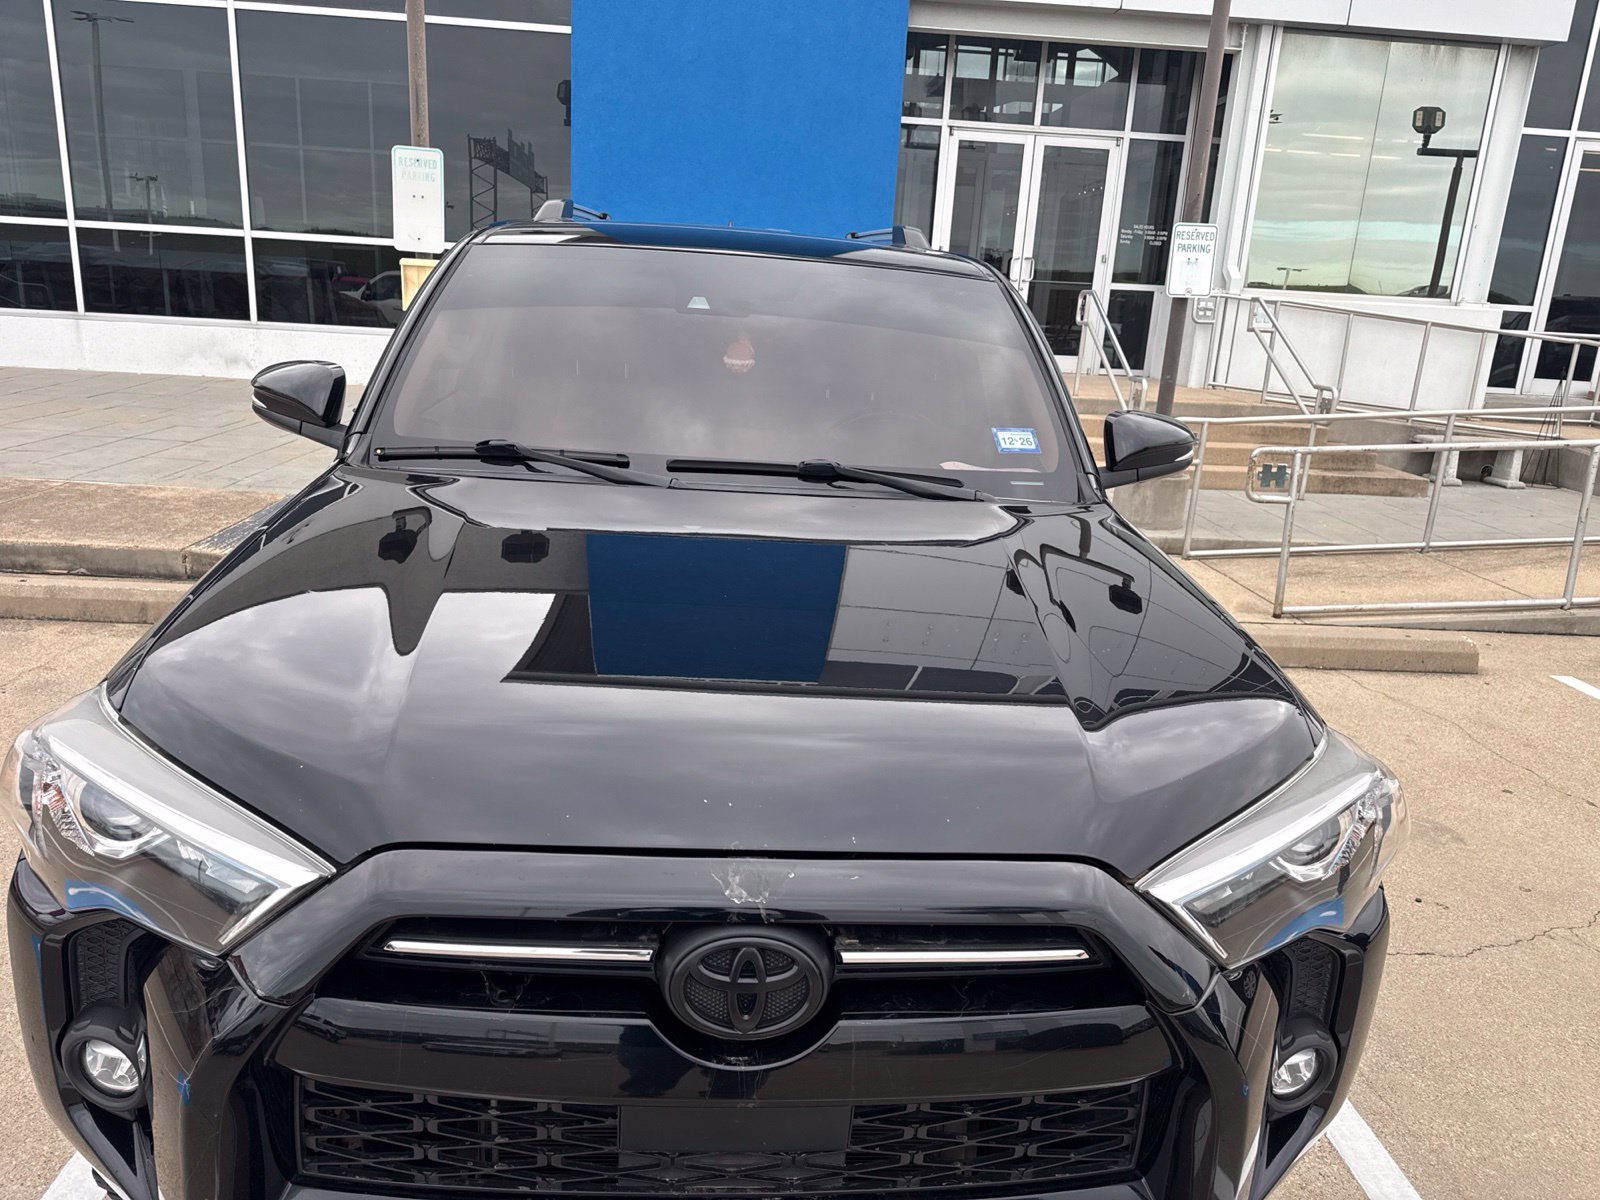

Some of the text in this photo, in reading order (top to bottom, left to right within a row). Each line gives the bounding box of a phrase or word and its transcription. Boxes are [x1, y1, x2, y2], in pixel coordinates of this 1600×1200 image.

[398, 156, 437, 169] RESERVED
[1176, 230, 1216, 242] RESERVED
[1176, 243, 1212, 254] PARKING
